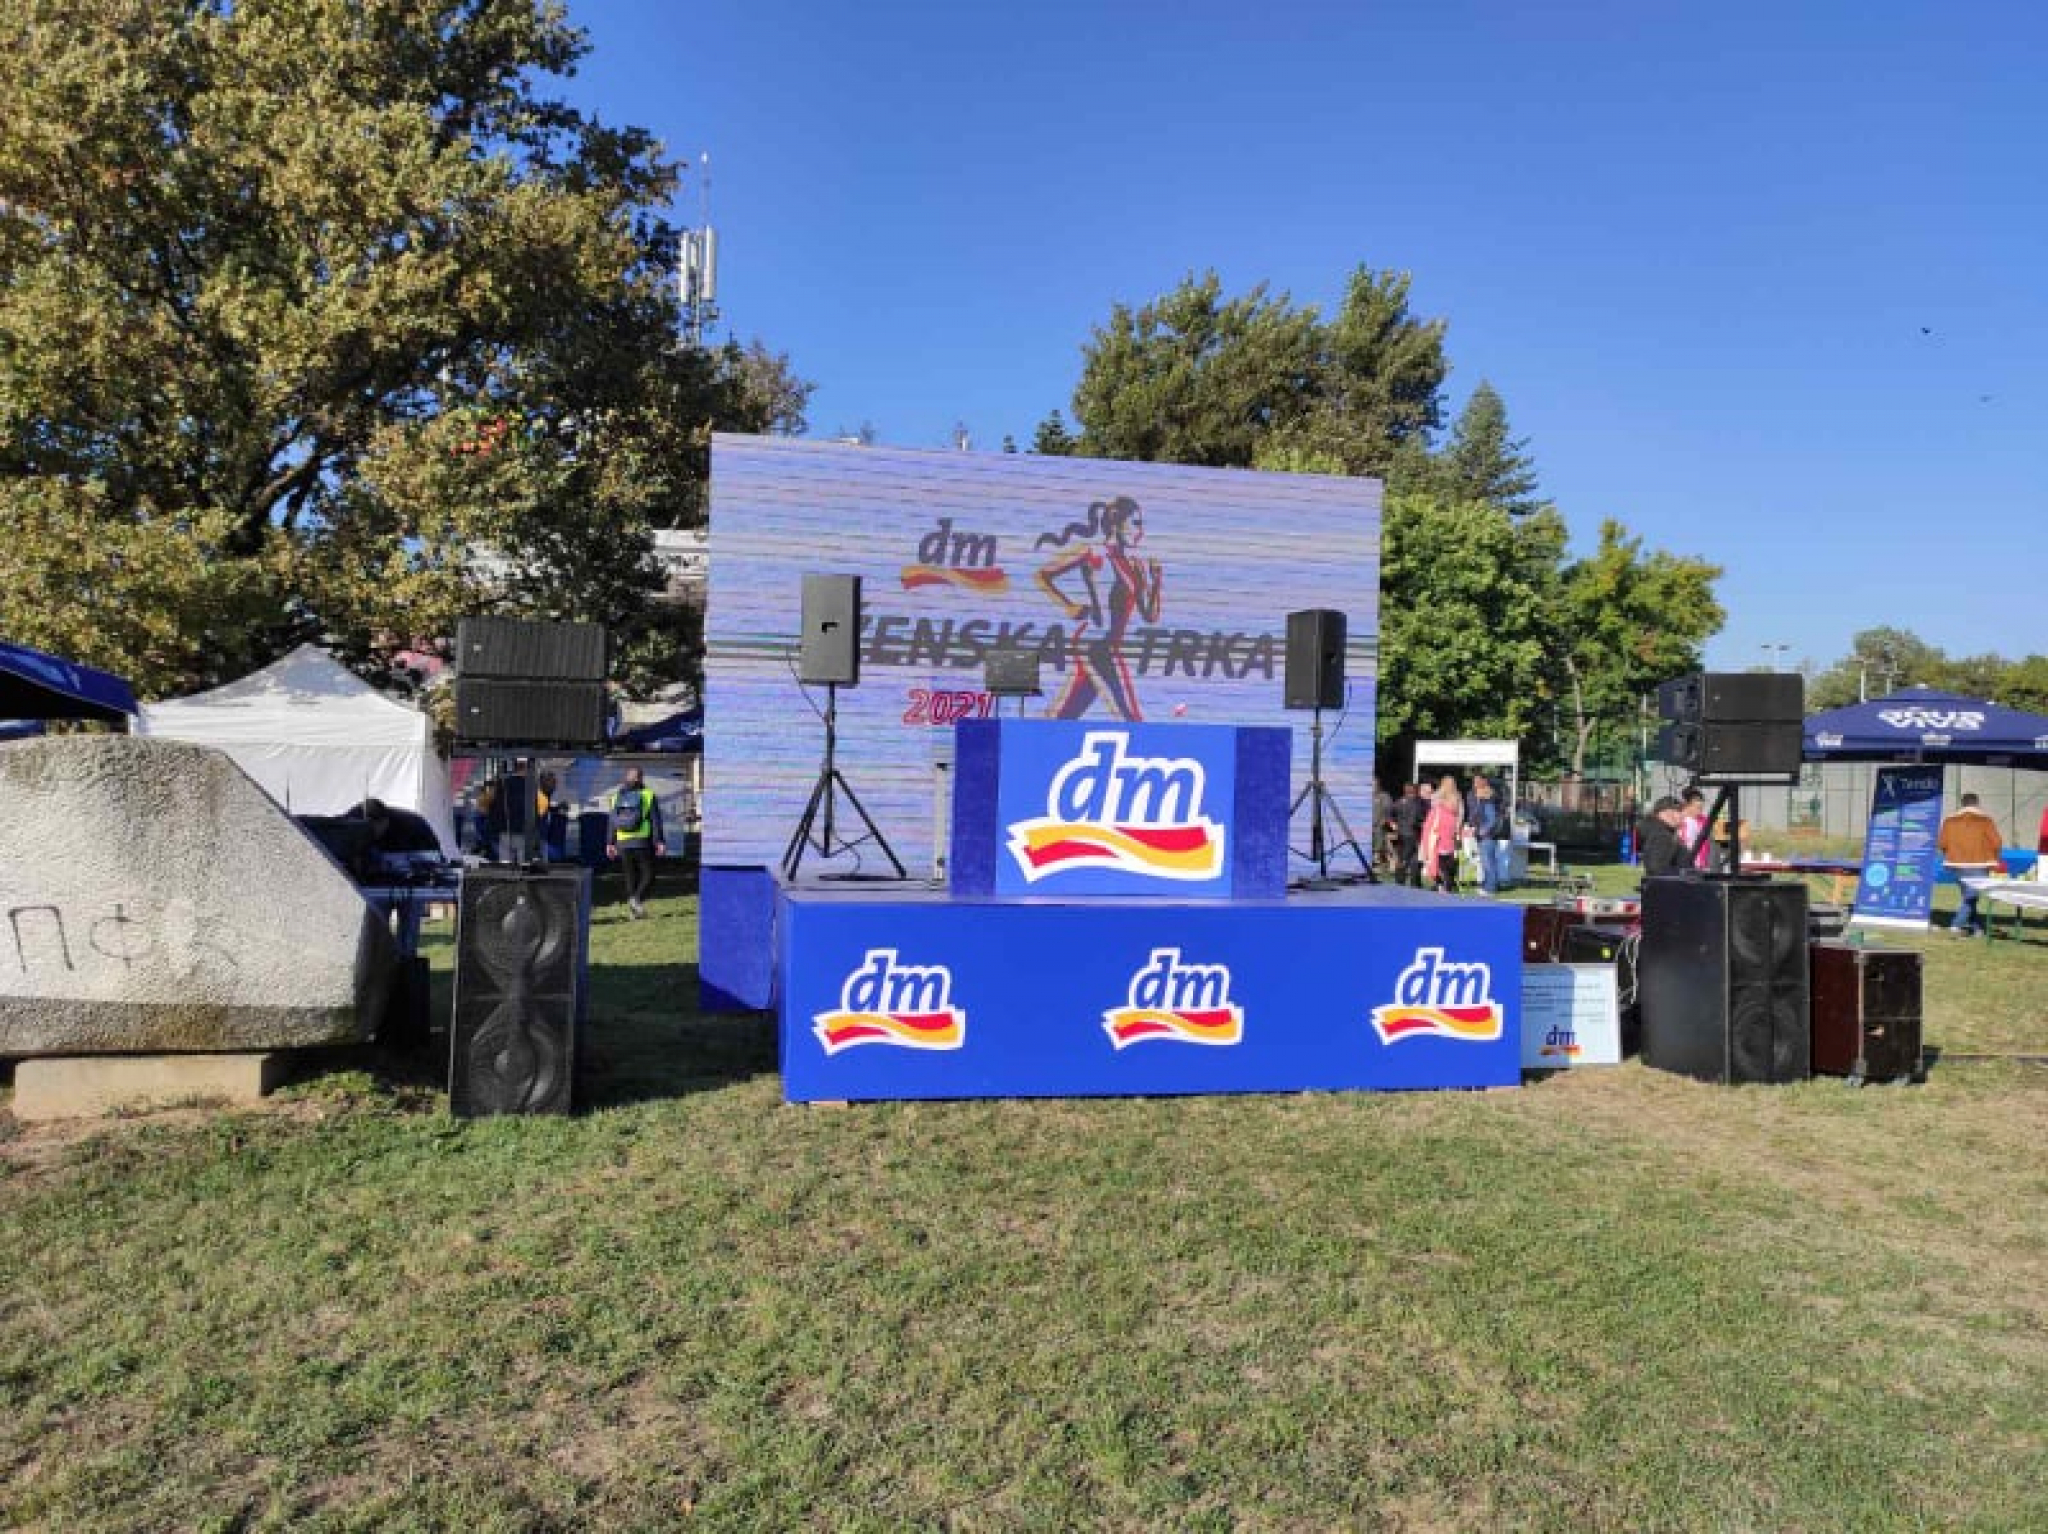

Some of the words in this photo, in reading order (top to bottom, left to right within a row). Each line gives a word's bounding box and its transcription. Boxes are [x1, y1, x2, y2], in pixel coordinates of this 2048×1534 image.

[917, 517, 998, 568] dm
[1135, 627, 1276, 680] TRKA
[902, 688, 994, 726] 2021
[1055, 736, 1199, 824] dm
[846, 953, 948, 1013] dm
[1133, 952, 1226, 1010] dm
[1399, 952, 1486, 1006] dm
[1545, 1023, 1577, 1046] dm
